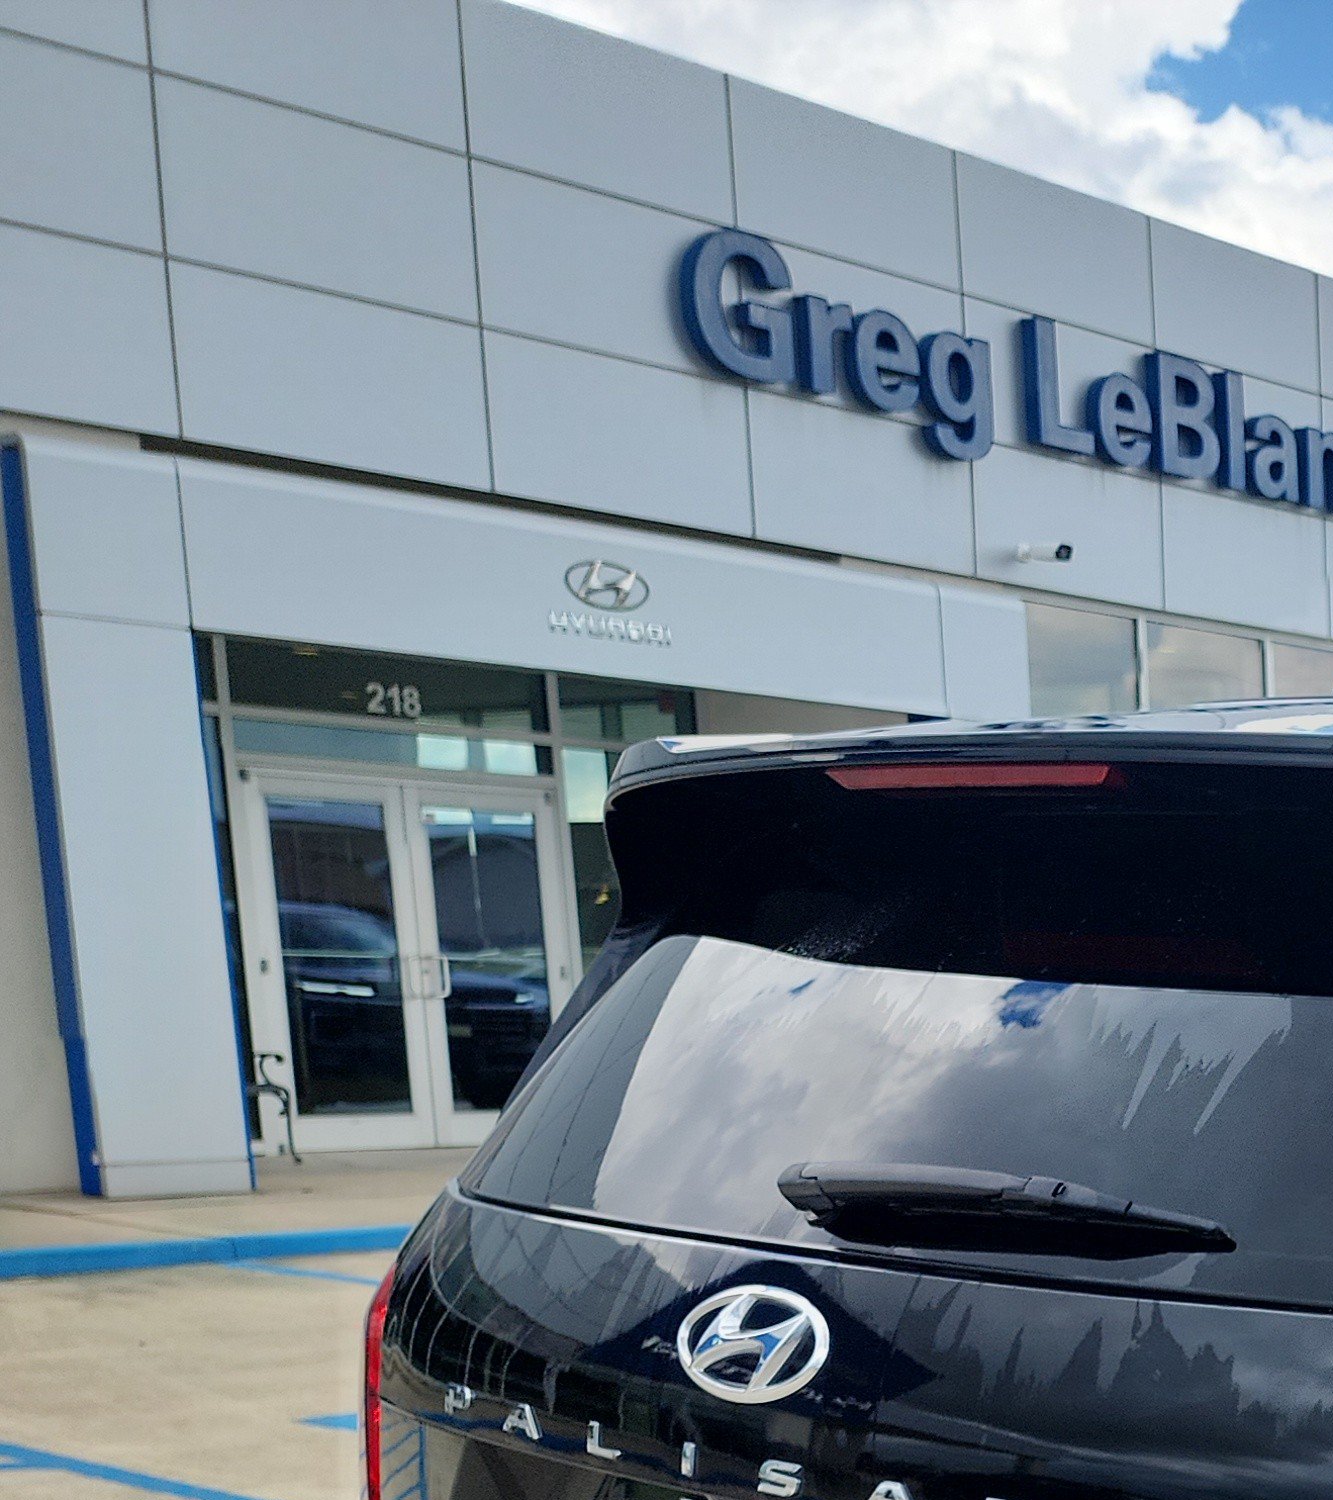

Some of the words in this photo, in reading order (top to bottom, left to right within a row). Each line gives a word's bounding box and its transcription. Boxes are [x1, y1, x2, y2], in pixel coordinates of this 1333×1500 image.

[679, 227, 993, 461] Greg
[549, 610, 672, 646] HYUNDAI
[365, 681, 421, 718] 218
